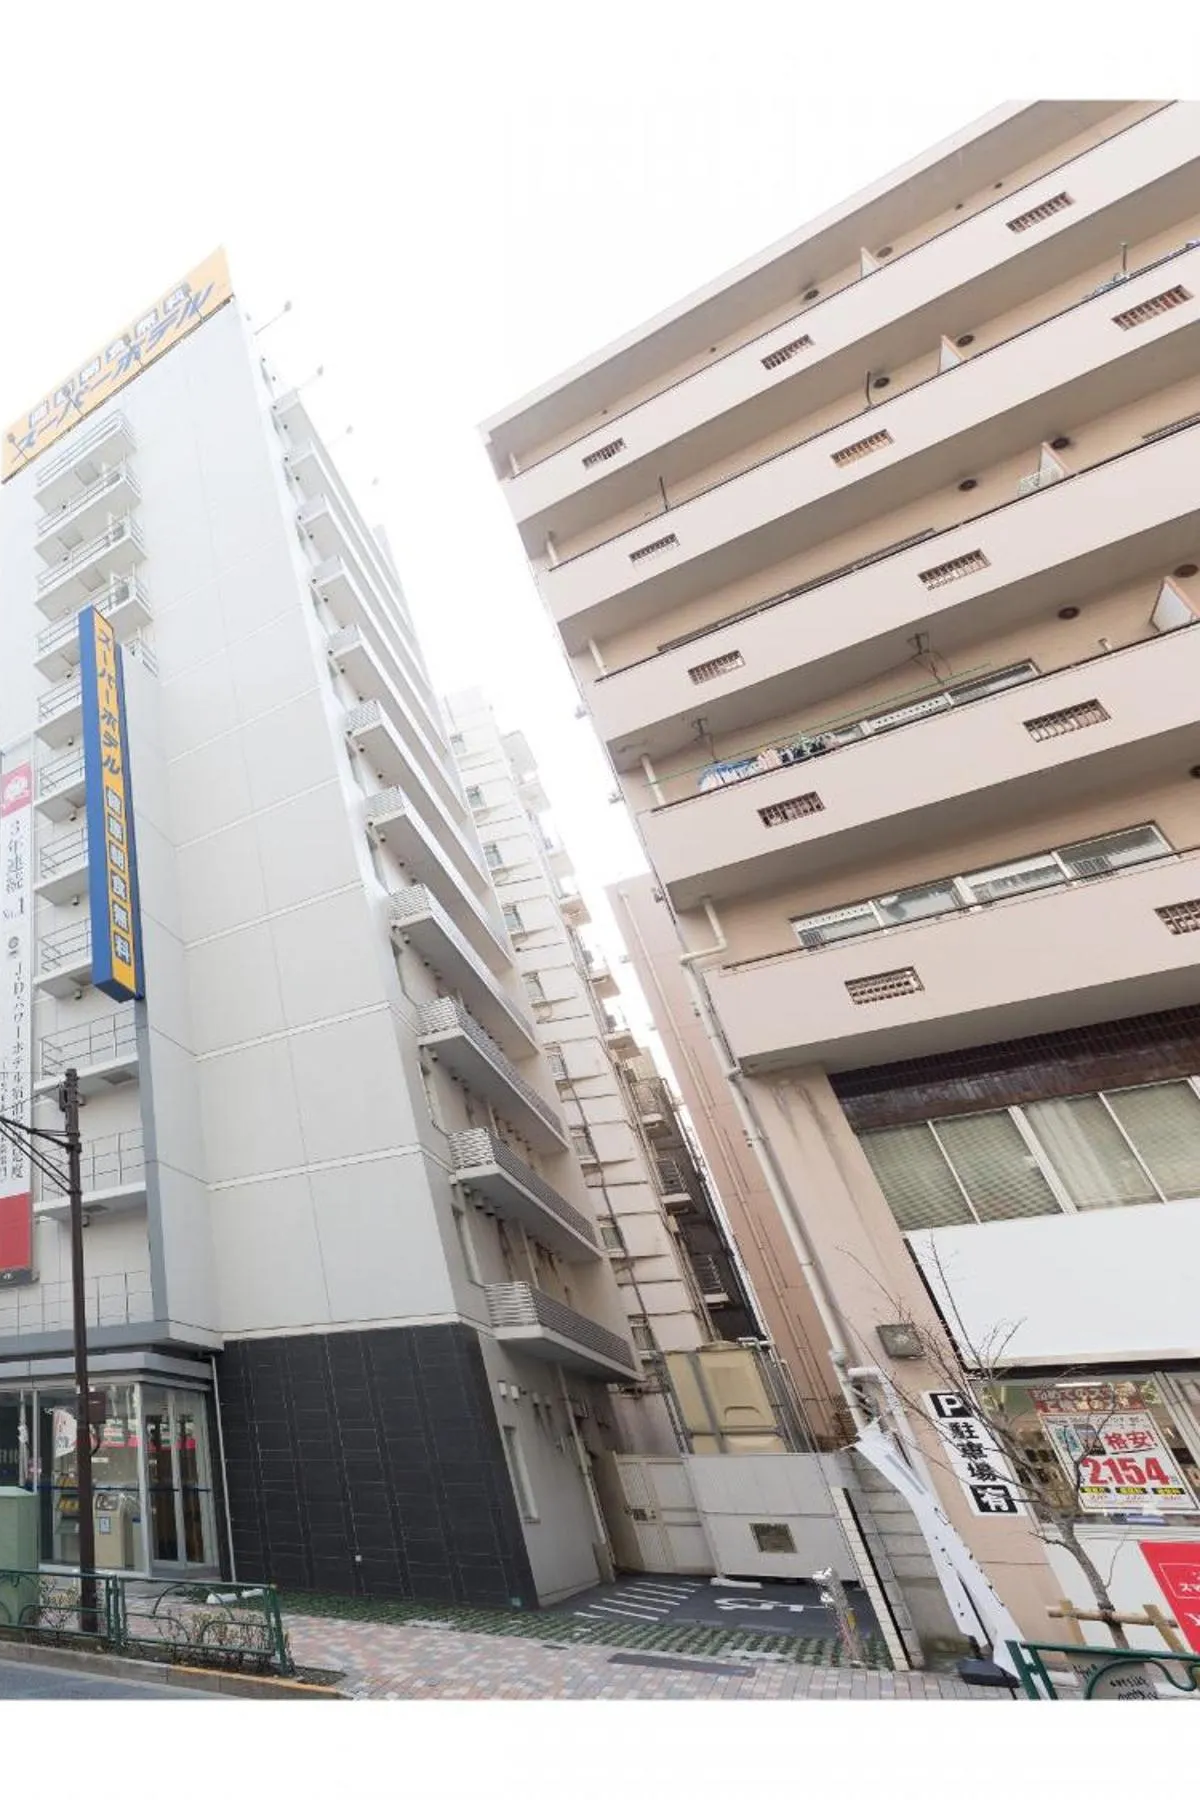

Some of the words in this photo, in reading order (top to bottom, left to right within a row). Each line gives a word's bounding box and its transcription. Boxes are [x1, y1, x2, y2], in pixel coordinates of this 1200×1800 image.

[937, 1394, 963, 1417] P
[948, 1421, 997, 1482] 駐車場
